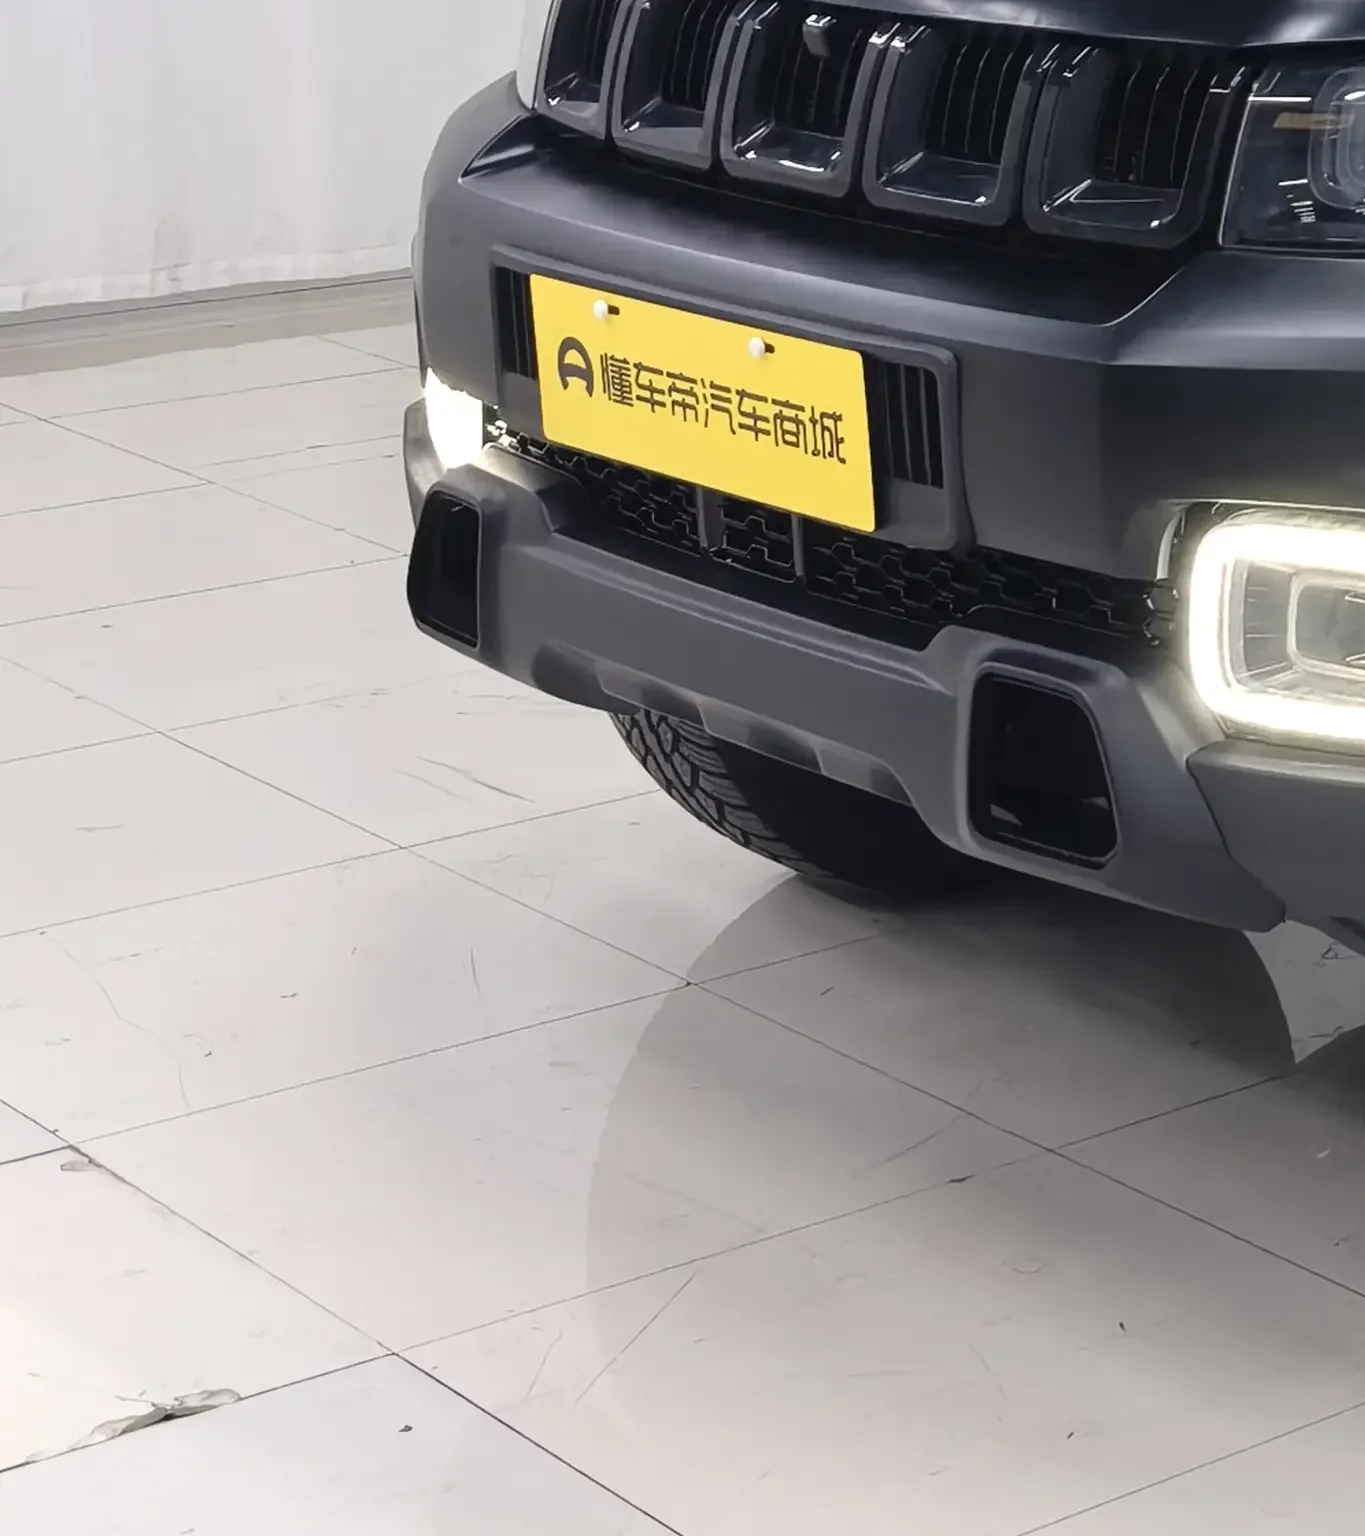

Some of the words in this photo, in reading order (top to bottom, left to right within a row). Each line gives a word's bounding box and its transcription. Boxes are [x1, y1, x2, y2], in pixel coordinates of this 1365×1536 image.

[600, 352, 847, 464] 懂车帝汽车商城
